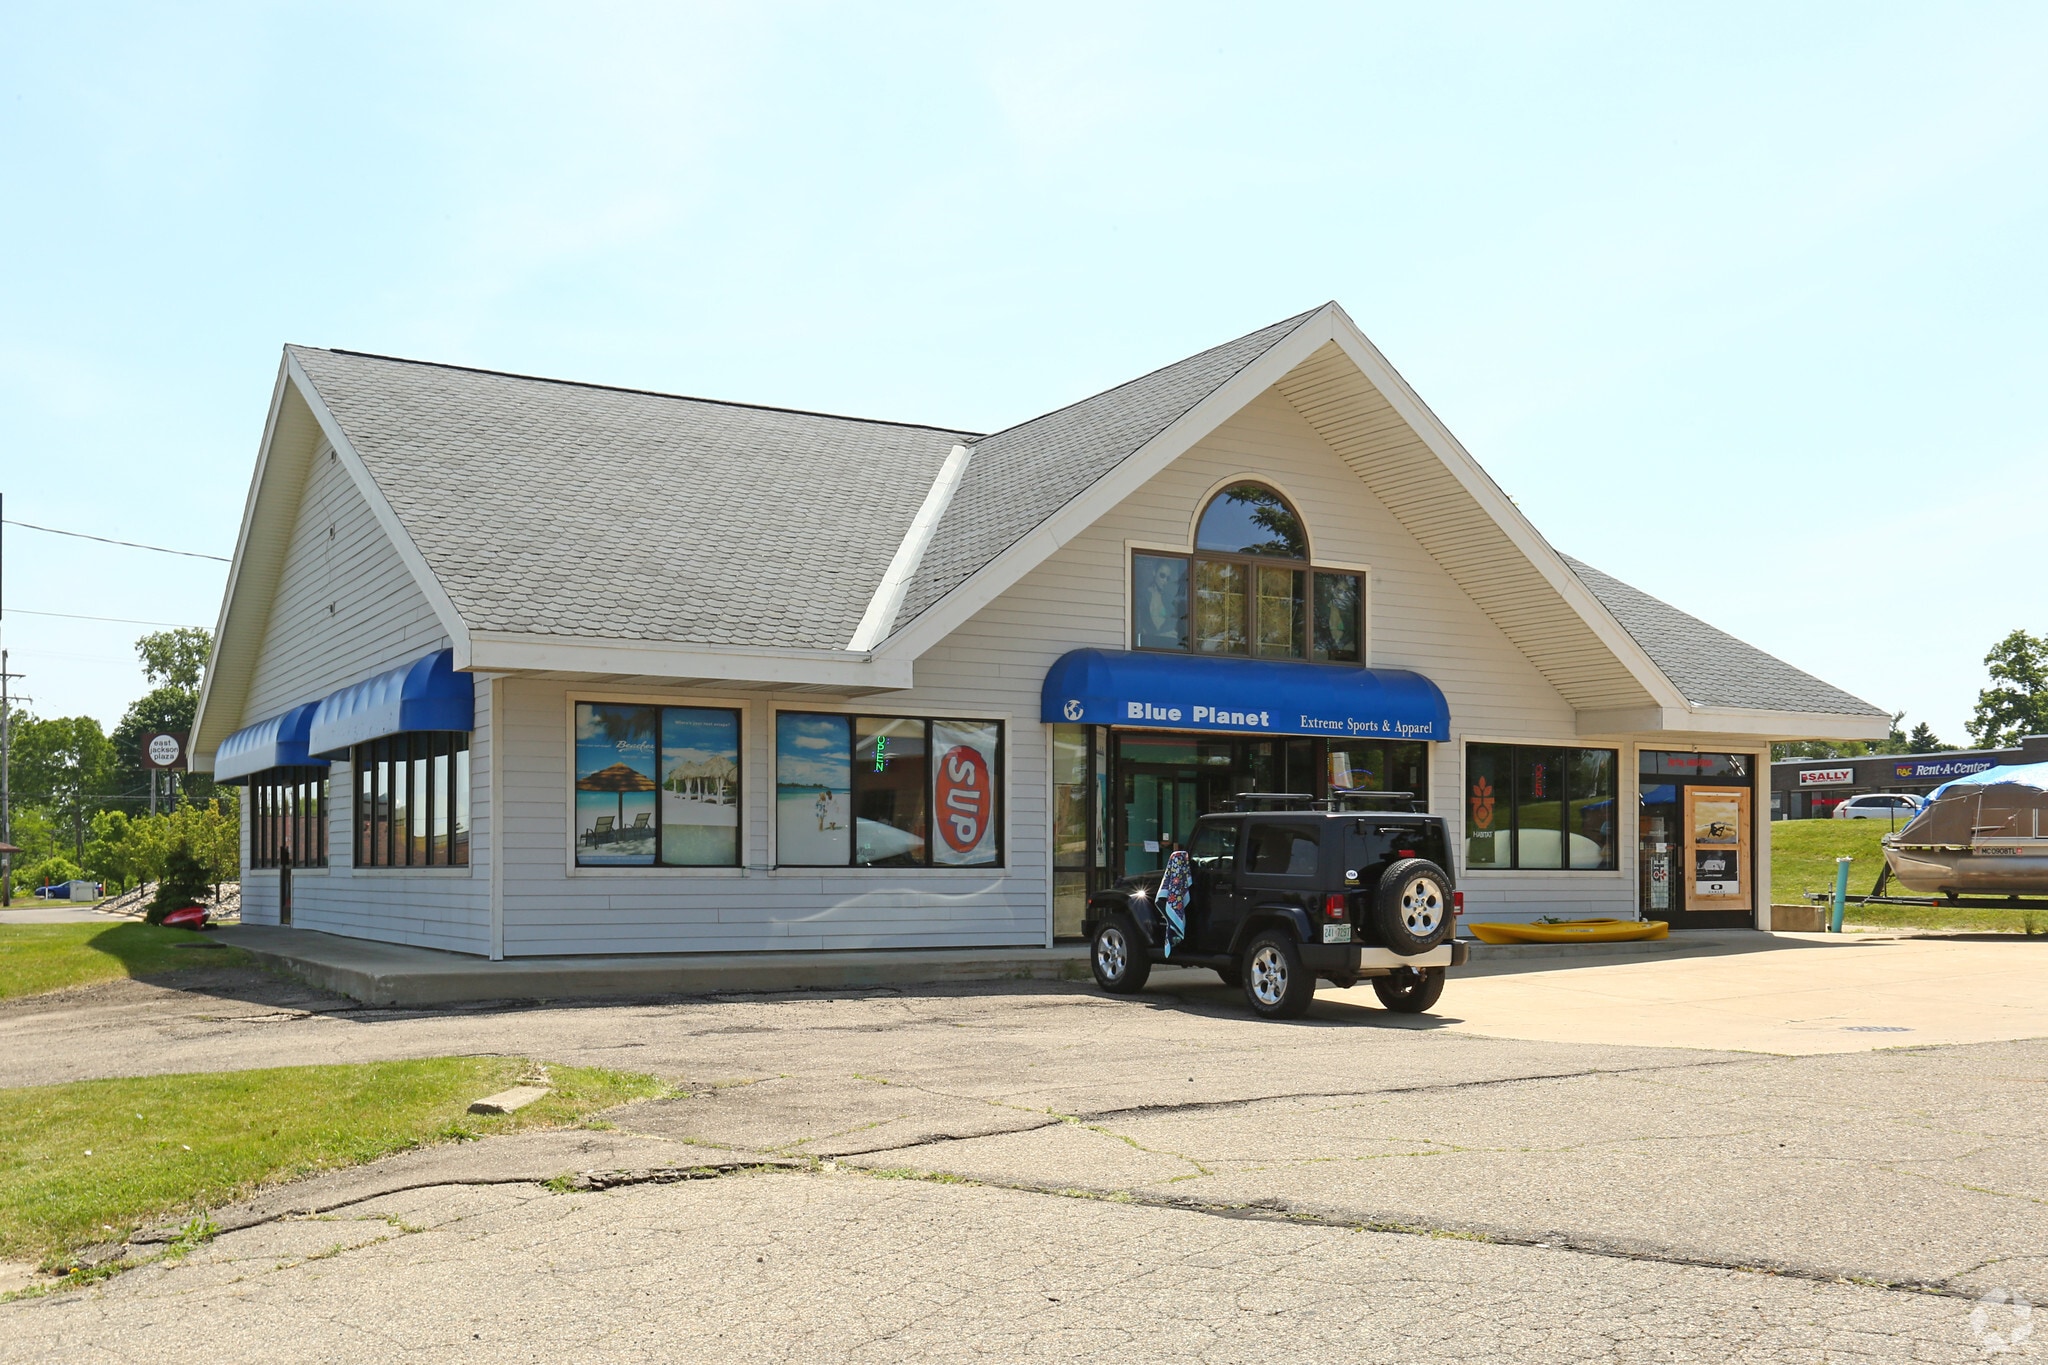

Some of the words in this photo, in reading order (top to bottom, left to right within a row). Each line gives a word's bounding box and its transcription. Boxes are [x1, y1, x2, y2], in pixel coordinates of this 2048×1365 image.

[1127, 701, 1182, 721] Blue
[1193, 705, 1269, 727] Planet
[1300, 715, 1344, 730] Extreme
[1347, 717, 1378, 735] Sports
[1382, 719, 1391, 732] &
[1394, 720, 1432, 737] Apparel
[151, 746, 178, 754] jackson
[1808, 771, 1850, 781] SALLY
[946, 756, 981, 843] SUP
